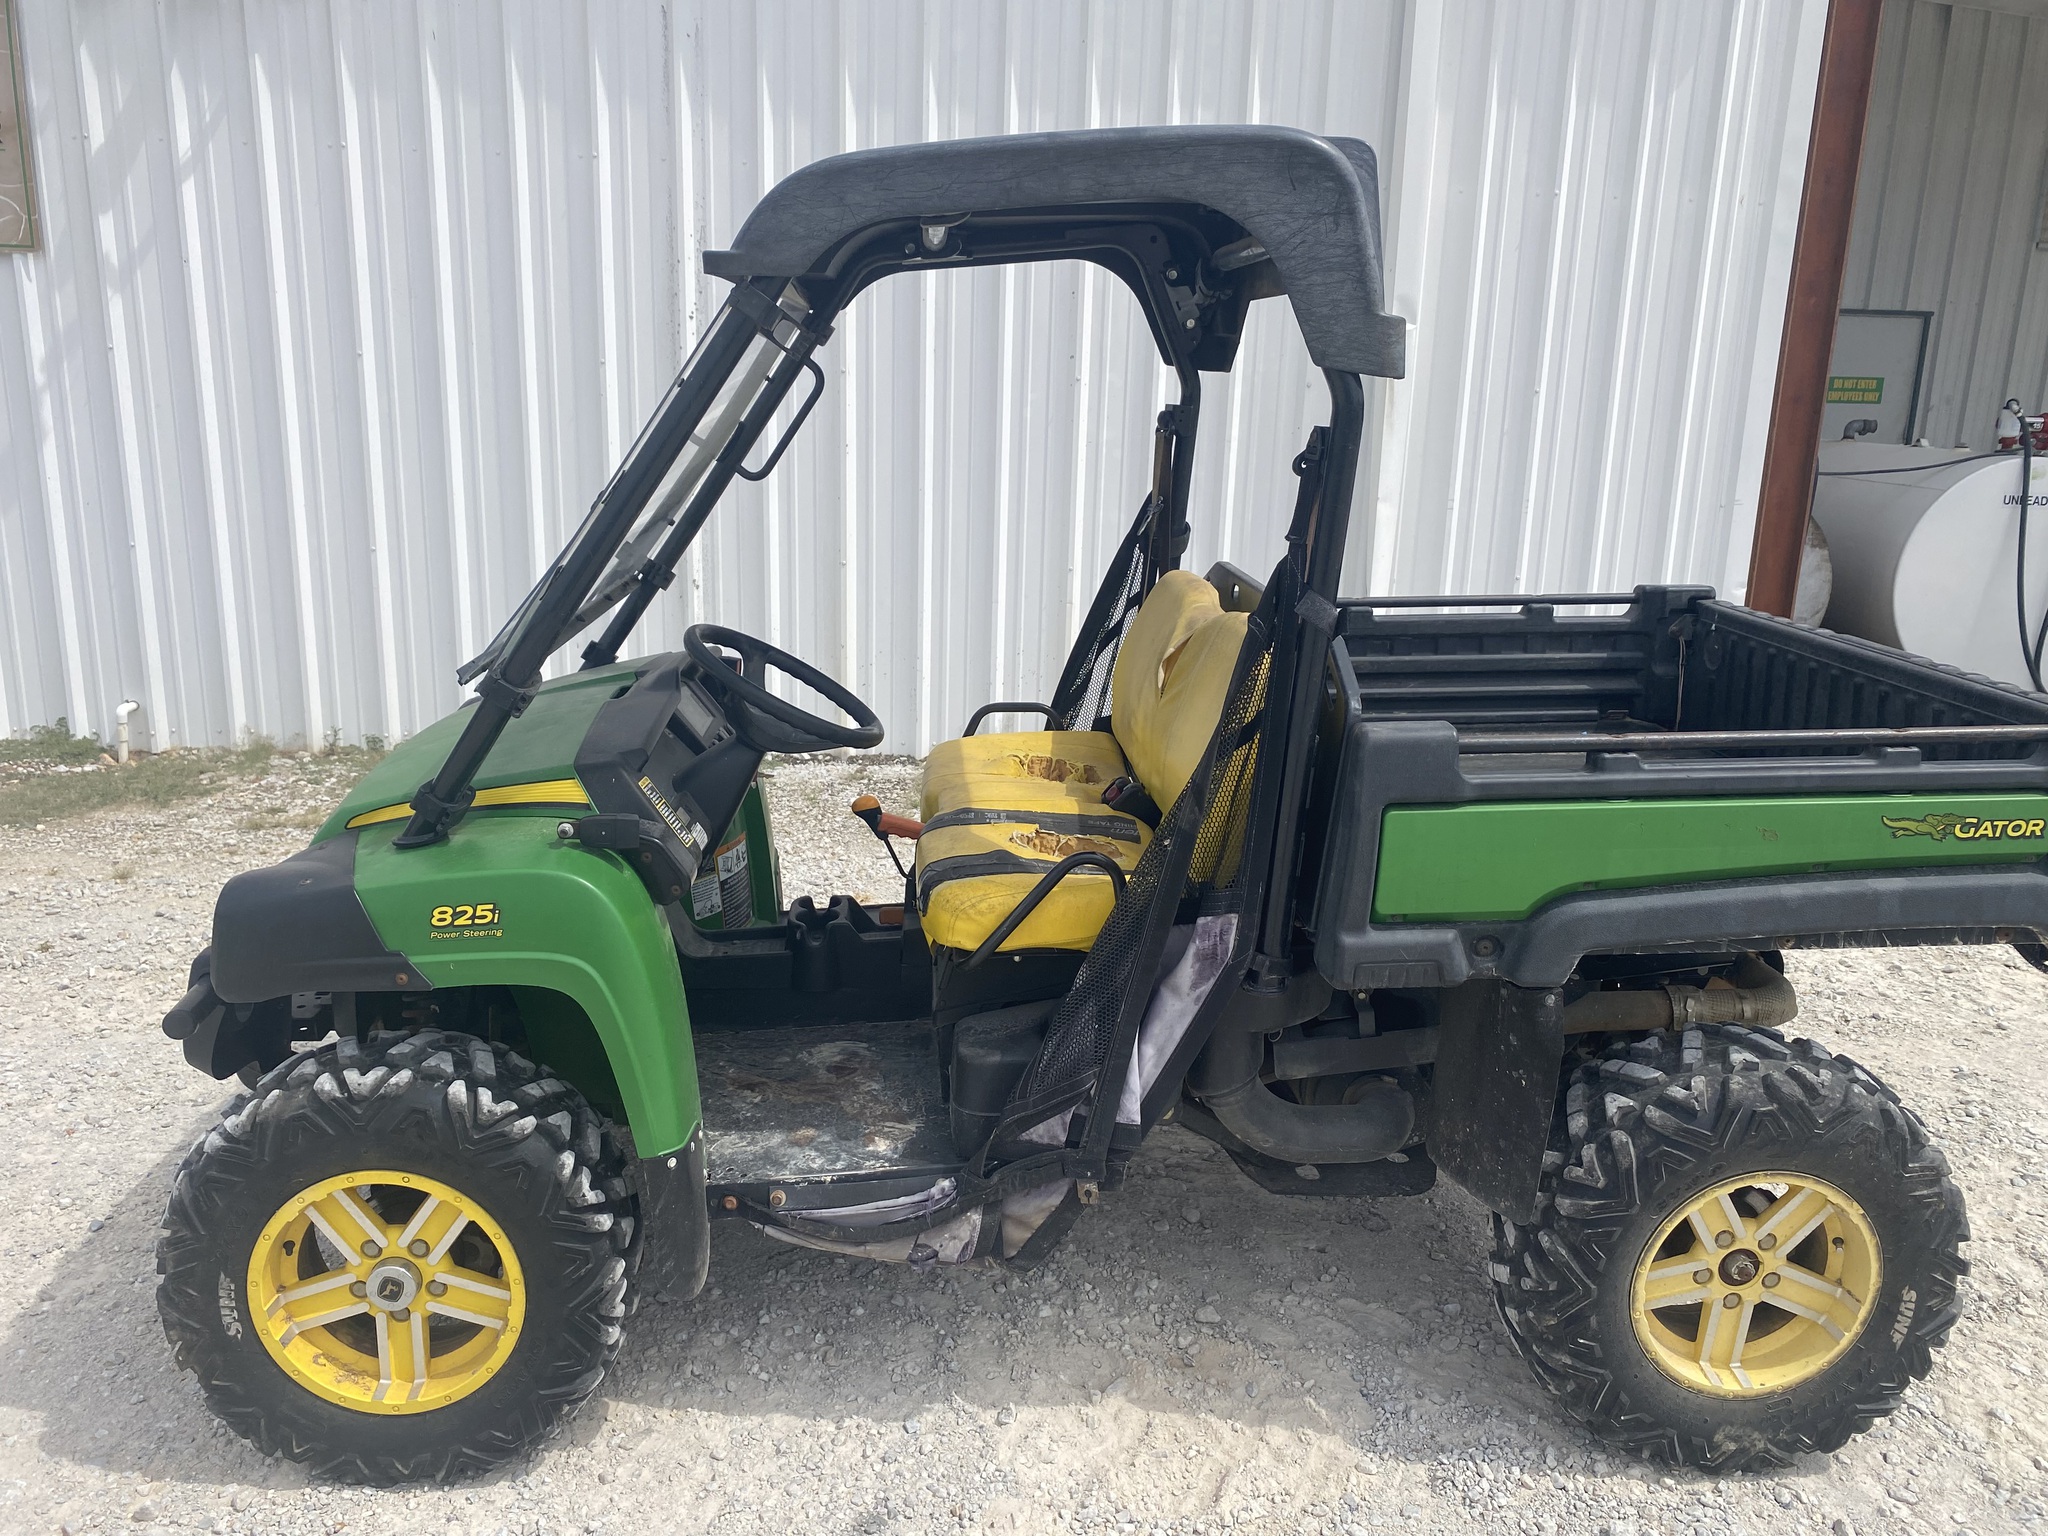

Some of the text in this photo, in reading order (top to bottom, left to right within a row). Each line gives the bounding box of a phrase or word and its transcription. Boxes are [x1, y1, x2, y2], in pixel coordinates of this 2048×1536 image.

[1833, 379, 1878, 389] DO NOT ENTER
[1827, 391, 1880, 402] EMPLOYEES ONLY
[1954, 817, 2045, 840] GATOR
[430, 903, 500, 927] 825i
[430, 928, 504, 940] Power Steering
